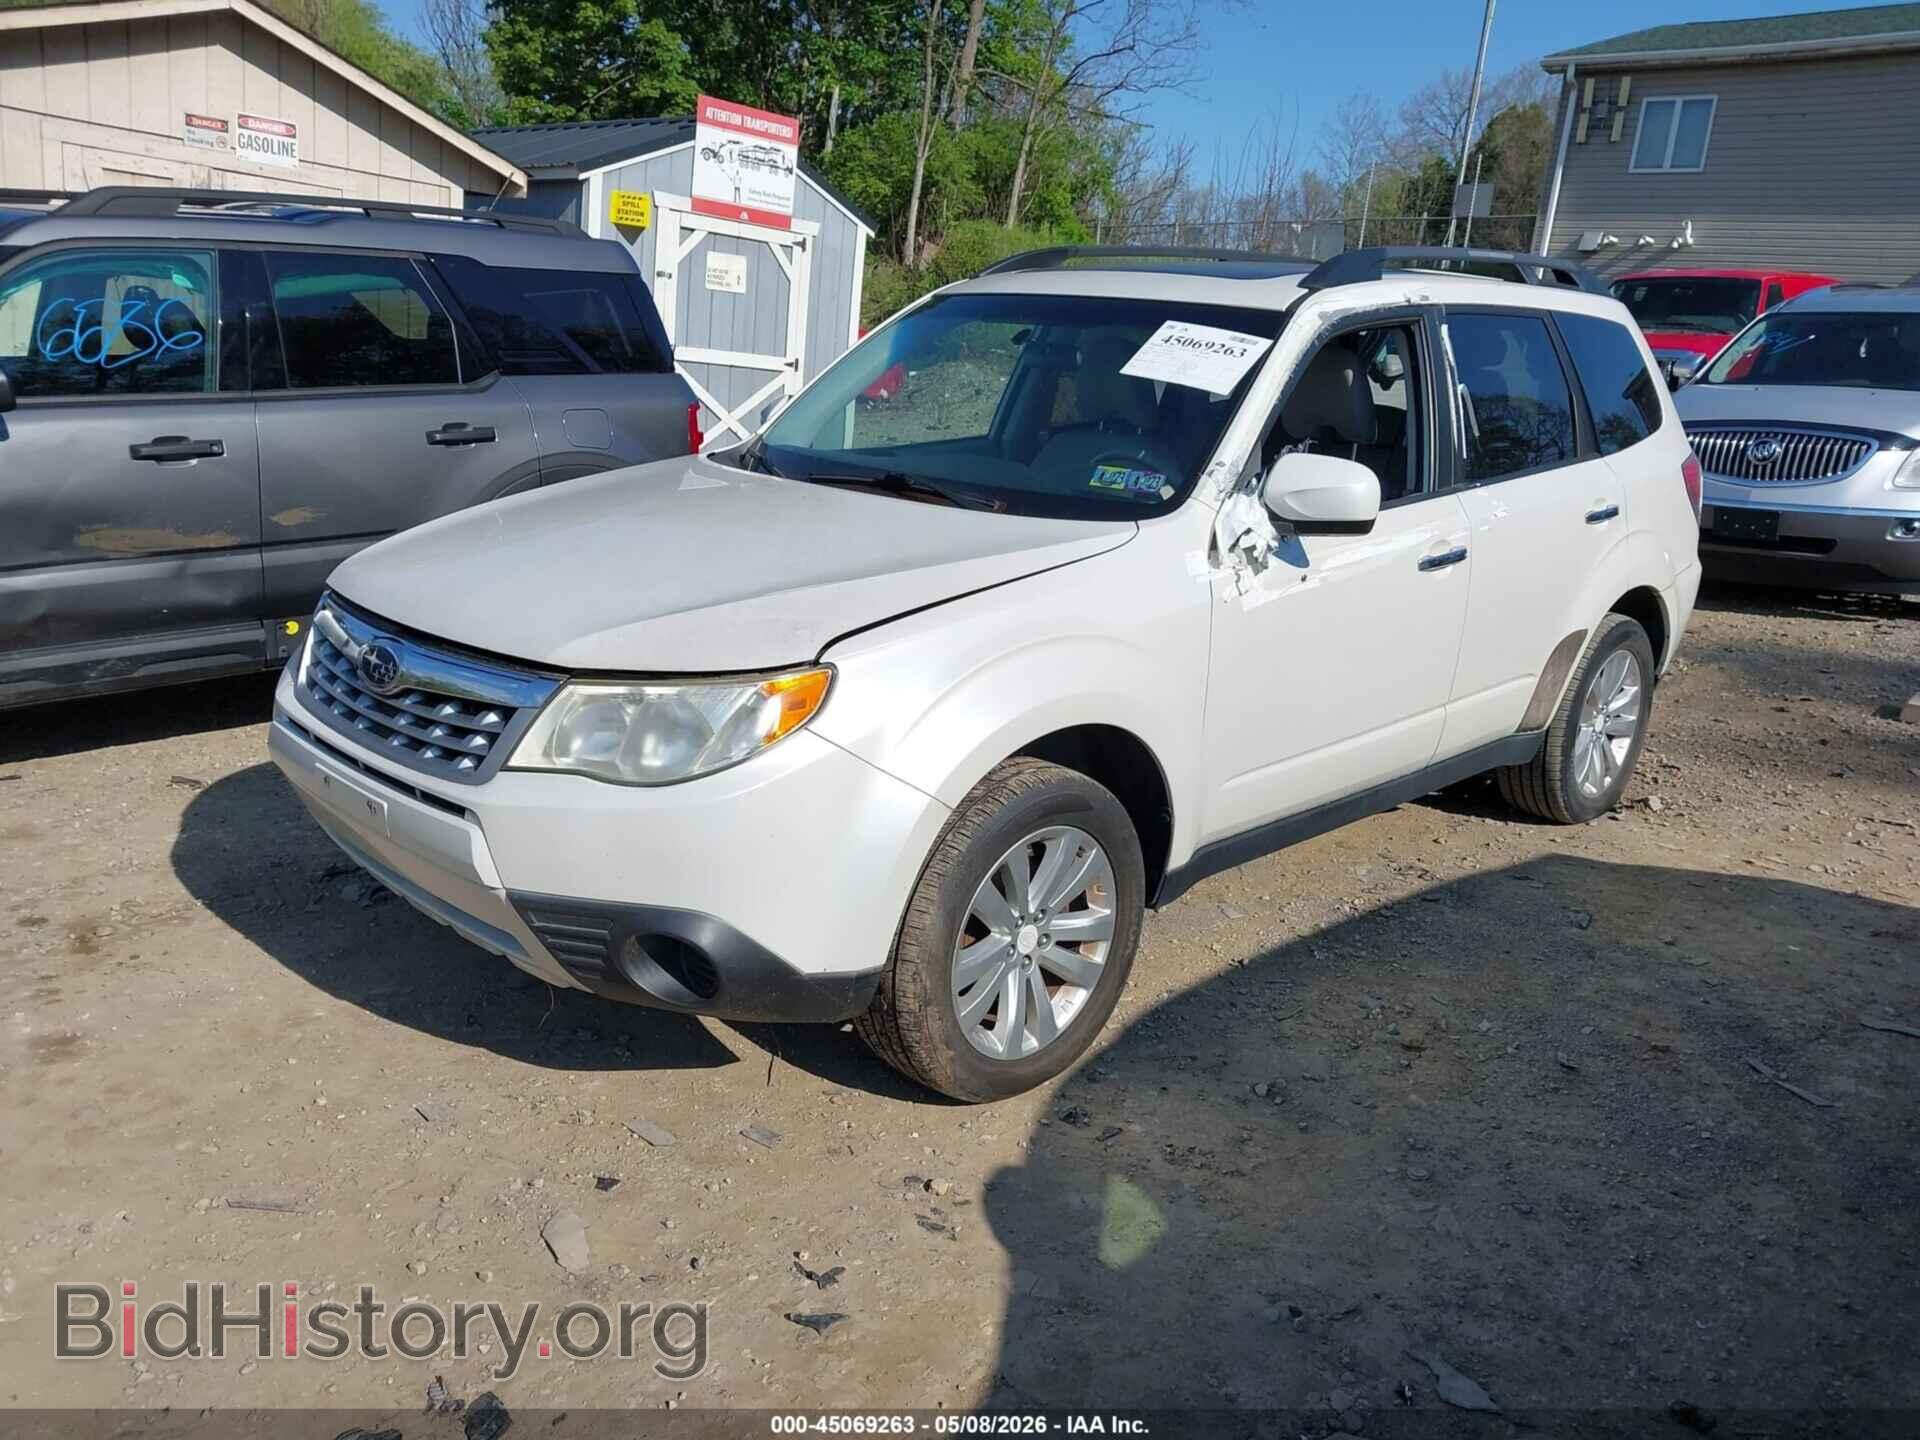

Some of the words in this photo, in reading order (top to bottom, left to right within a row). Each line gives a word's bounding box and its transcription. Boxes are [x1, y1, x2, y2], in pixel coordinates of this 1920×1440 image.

[705, 106, 742, 126] ATTENTION
[192, 117, 222, 130] DANGER
[248, 119, 285, 133] DANGER
[238, 133, 297, 158] GASOLINE
[621, 200, 641, 209] SPILL
[616, 208, 645, 218] STATION
[1161, 334, 1248, 359] 45069263
